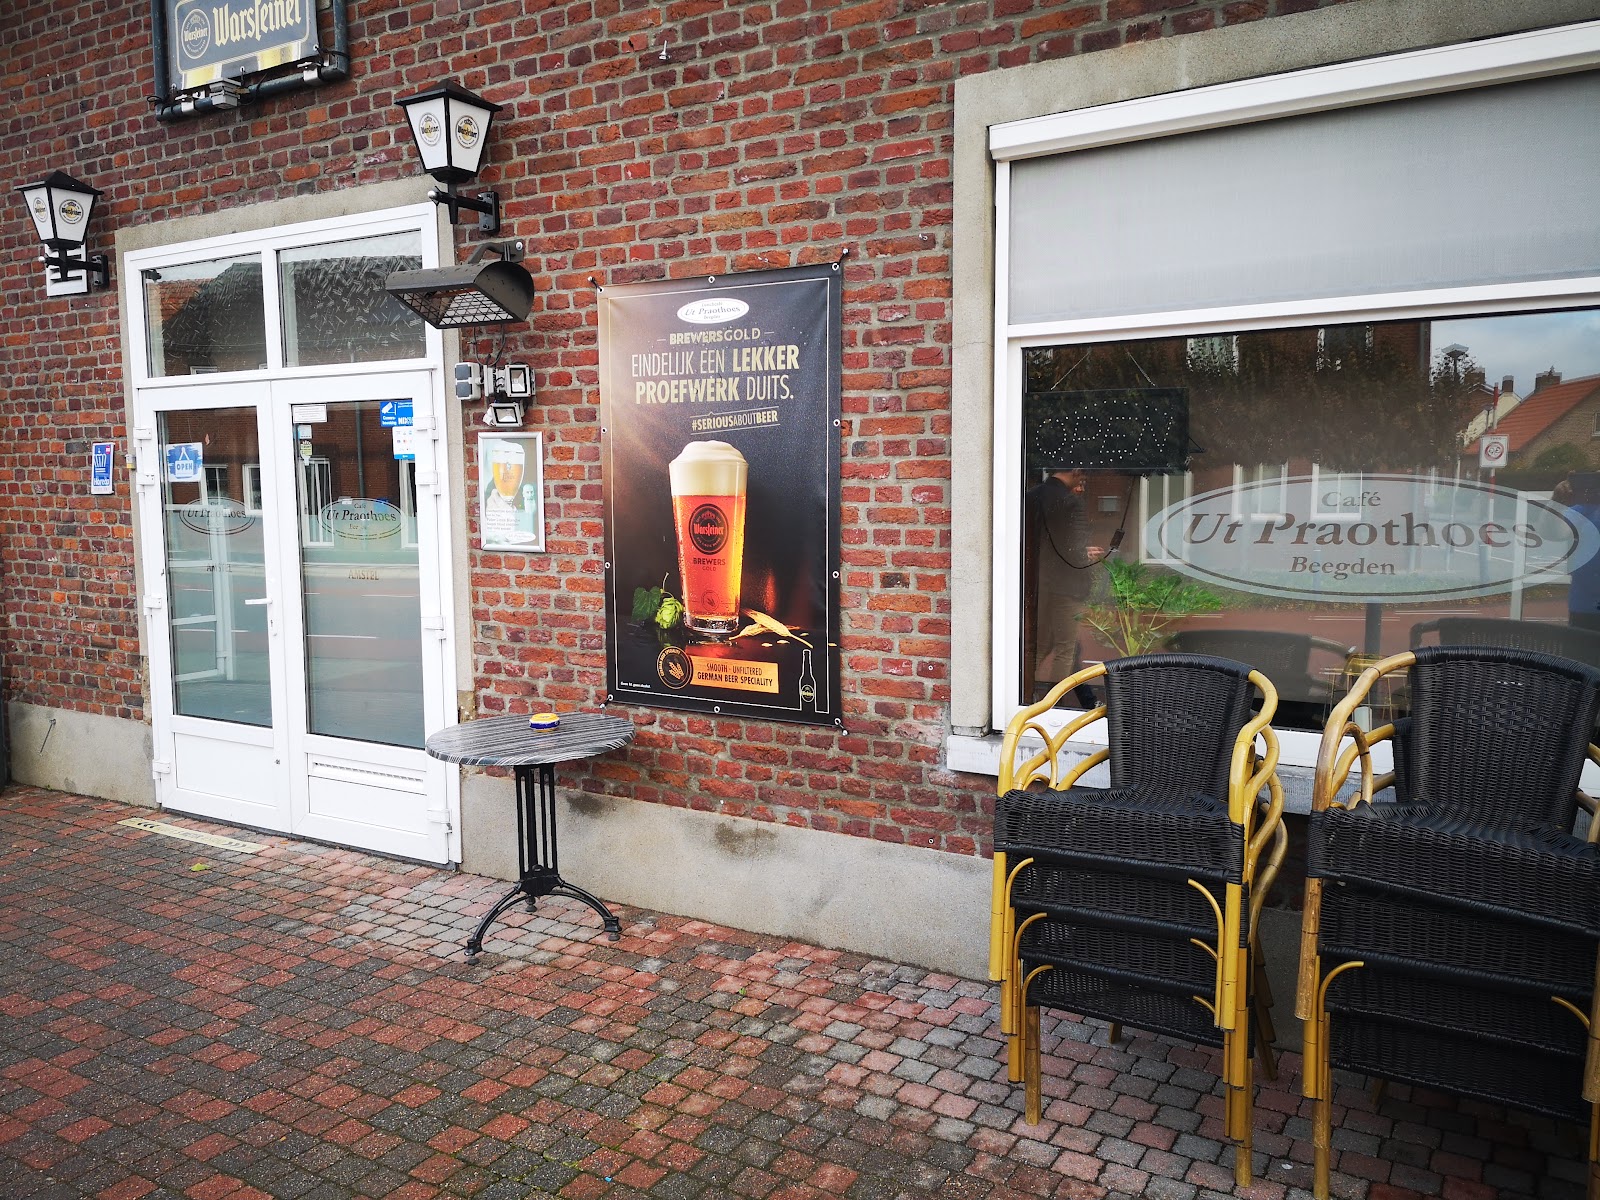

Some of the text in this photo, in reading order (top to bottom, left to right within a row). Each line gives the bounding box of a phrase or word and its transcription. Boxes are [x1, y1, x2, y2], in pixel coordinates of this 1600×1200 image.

[698, 306, 741, 315] Praothoes
[669, 327, 761, 345] BREWERSGOLD
[631, 351, 694, 378] EINDELIJK
[732, 345, 800, 373] LEKKER
[635, 374, 794, 404] PROEFWERK DUITS.
[691, 410, 778, 431] #SERIOUSABOUTBEER
[176, 462, 193, 471] OPEN
[1321, 491, 1381, 508] Café
[341, 509, 397, 522] Praothoes
[1183, 511, 1544, 549] Ut Praothoes
[692, 557, 726, 566] BREWERS
[1288, 555, 1396, 580] Beegden
[348, 568, 380, 580] AMSTEL
[706, 663, 763, 676] SMOOTH UNFILTERED
[697, 671, 773, 687] GERMAN BEER SPECIALITY
